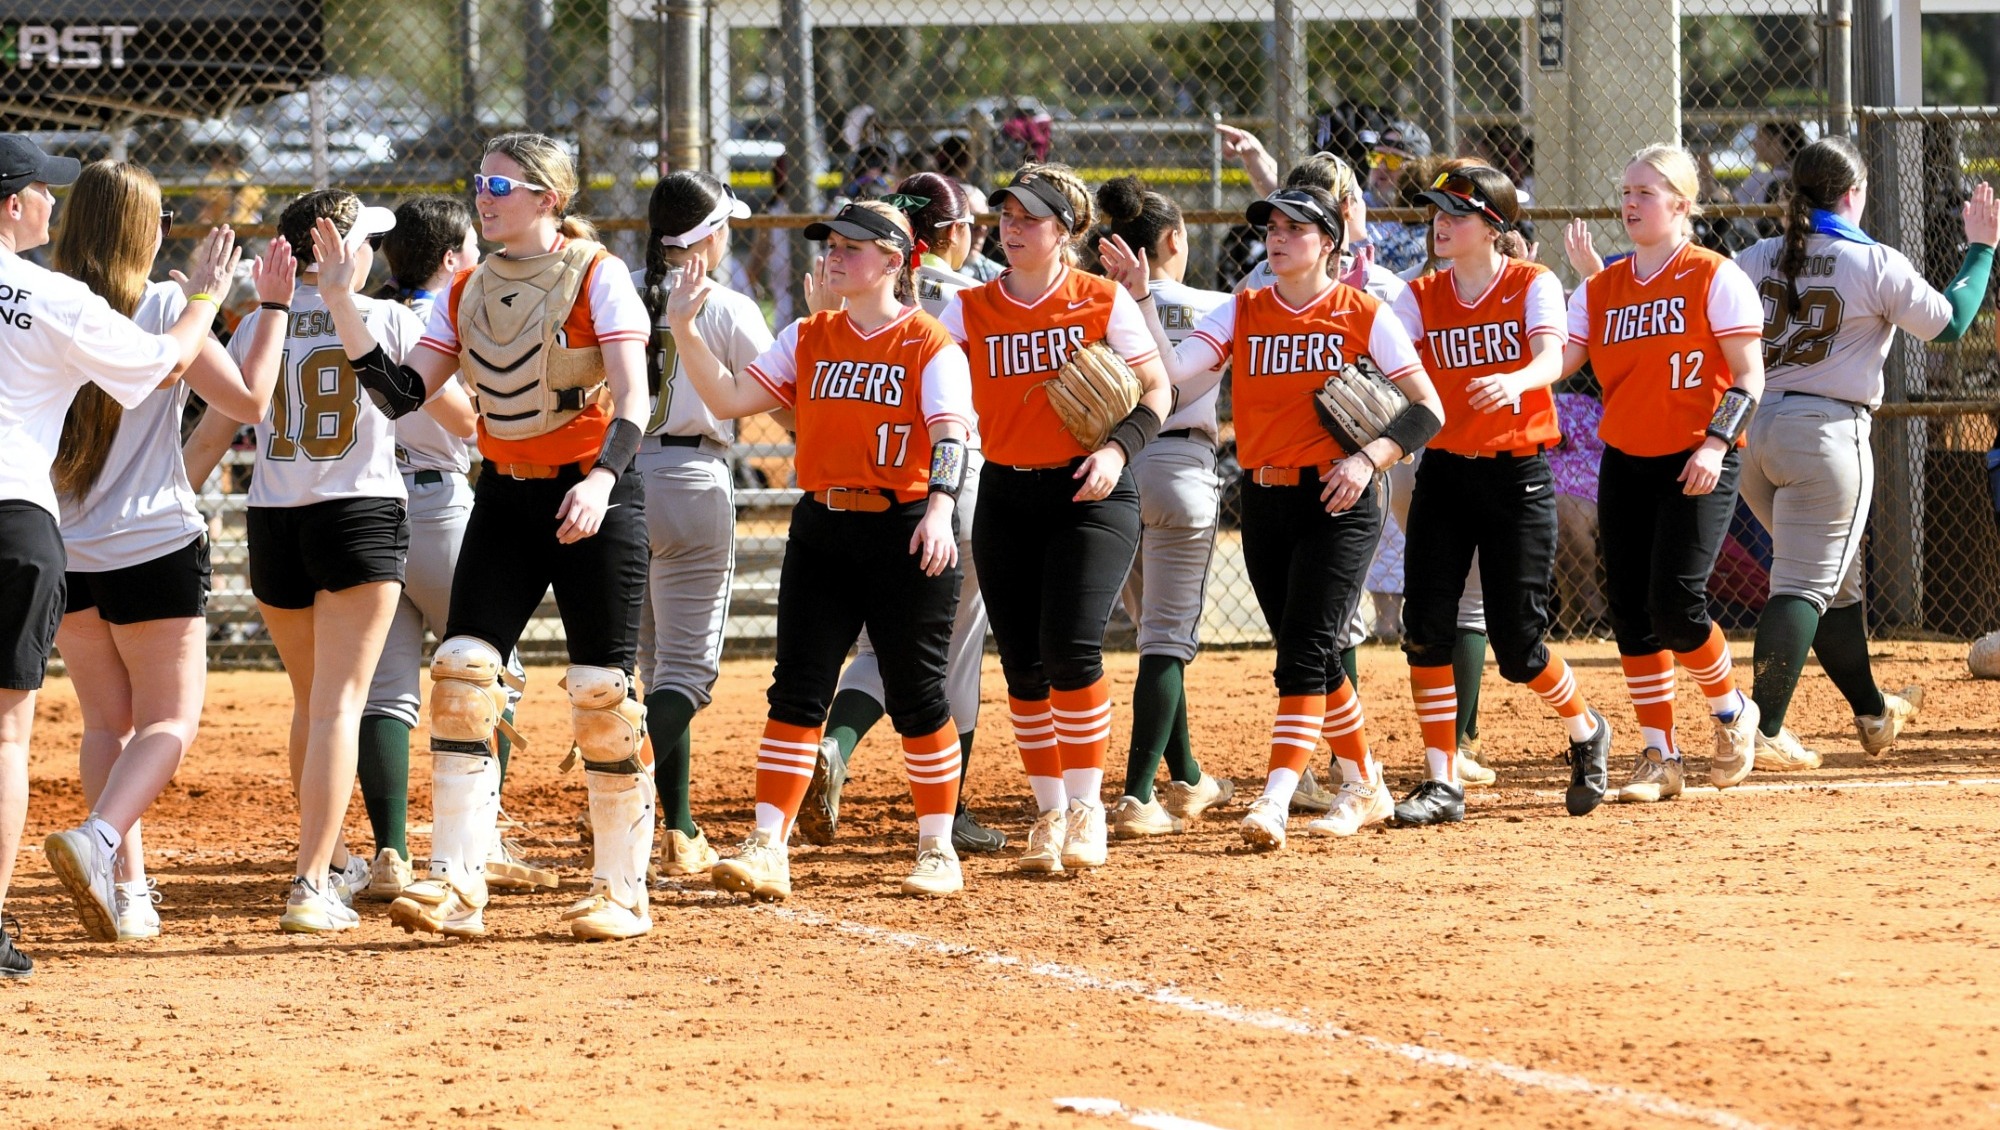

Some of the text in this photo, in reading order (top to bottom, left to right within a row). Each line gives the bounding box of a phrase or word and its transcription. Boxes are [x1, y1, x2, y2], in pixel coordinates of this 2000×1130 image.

[0, 284, 32, 304] OF
[1426, 319, 1521, 370] TIGERS
[1602, 296, 1687, 346] TIGERS
[985, 324, 1086, 379] TIGERS
[1247, 331, 1344, 377] TIGERS
[1668, 348, 1705, 390] 12
[266, 344, 362, 462] 18
[809, 360, 907, 408] TIGERS
[875, 421, 913, 467] 17
[1329, 404, 1338, 415] NO
[1345, 422, 1359, 440] ZONE
